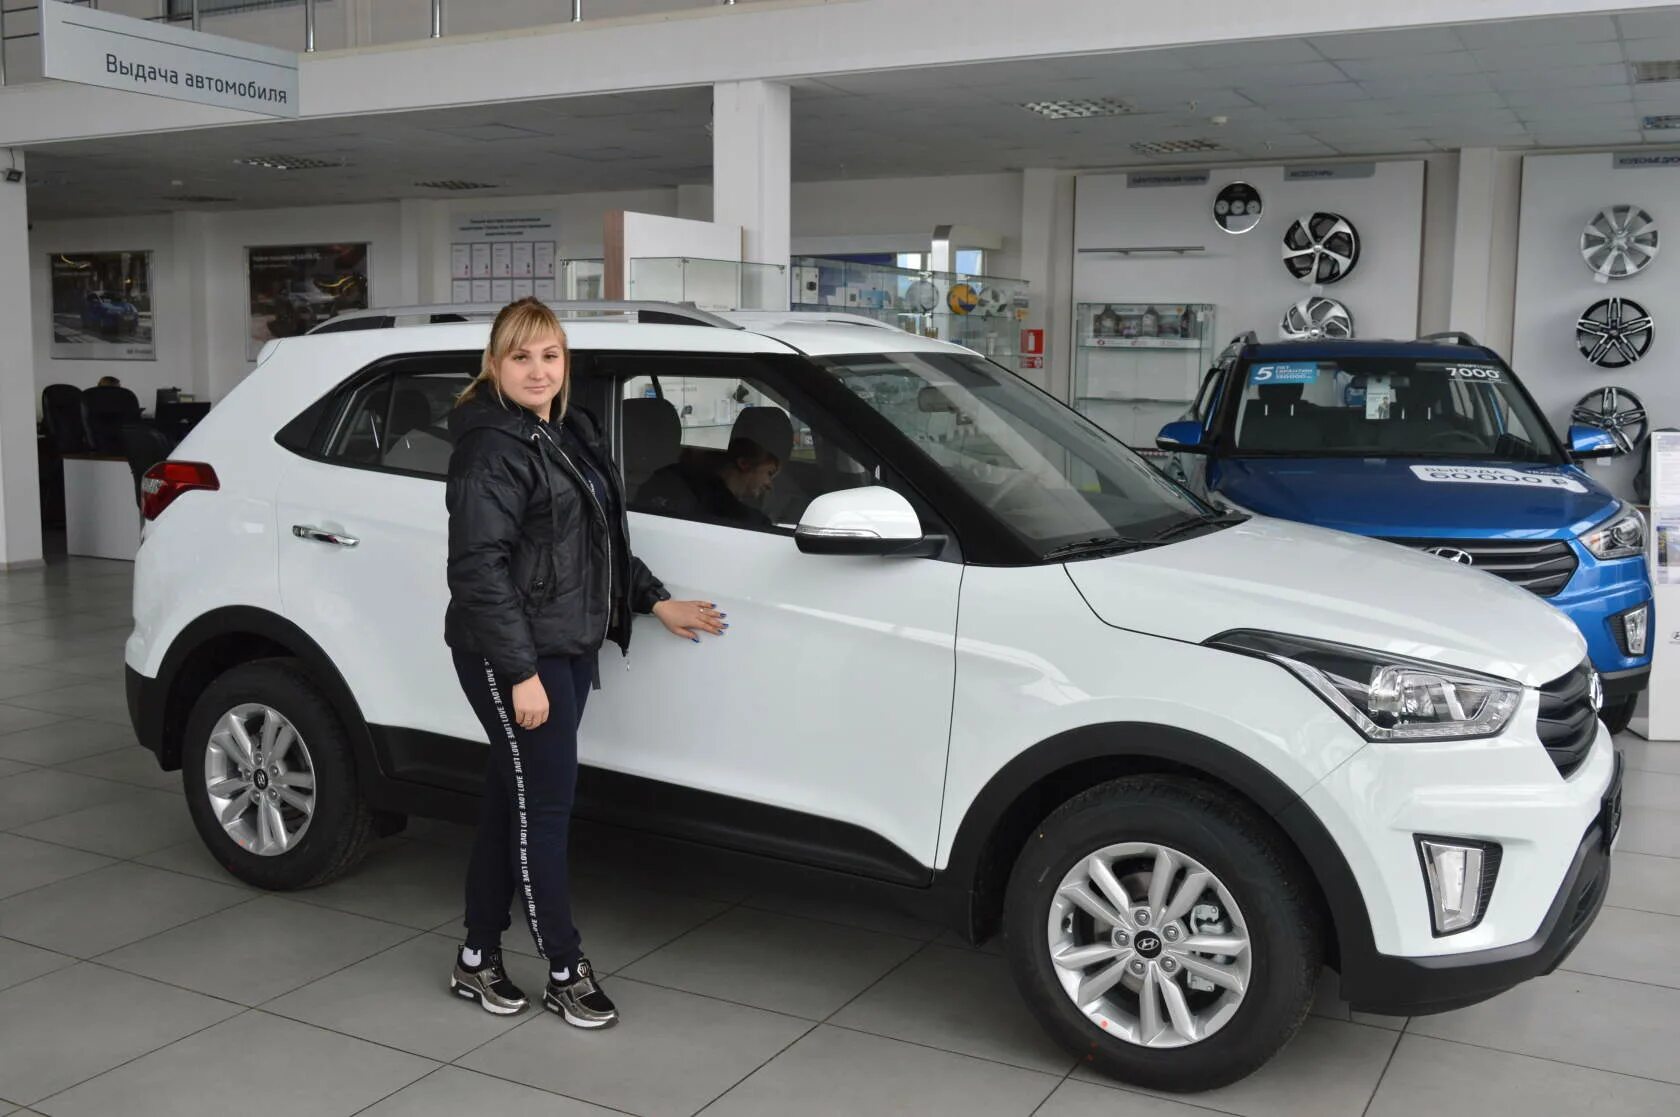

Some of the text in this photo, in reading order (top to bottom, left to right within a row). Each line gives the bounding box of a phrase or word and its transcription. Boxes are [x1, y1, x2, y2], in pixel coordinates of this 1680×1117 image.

[105, 53, 287, 104] Выдача автомобиля
[1254, 366, 1274, 380] 5
[485, 668, 496, 687] LOVE
[490, 688, 502, 705] LOVE
[497, 706, 509, 723] LOVE
[503, 723, 515, 739] LOVE
[509, 740, 520, 756] LOVE
[513, 757, 523, 773] LOVE
[516, 775, 526, 792] LOVE
[518, 793, 526, 809] LOVE
[519, 811, 528, 828] LOVE
[520, 829, 528, 845] LOVE
[520, 847, 528, 865] LOVE
[521, 866, 530, 882] LOVE
[524, 884, 533, 900] LOVE
[528, 900, 536, 917] LOVE
